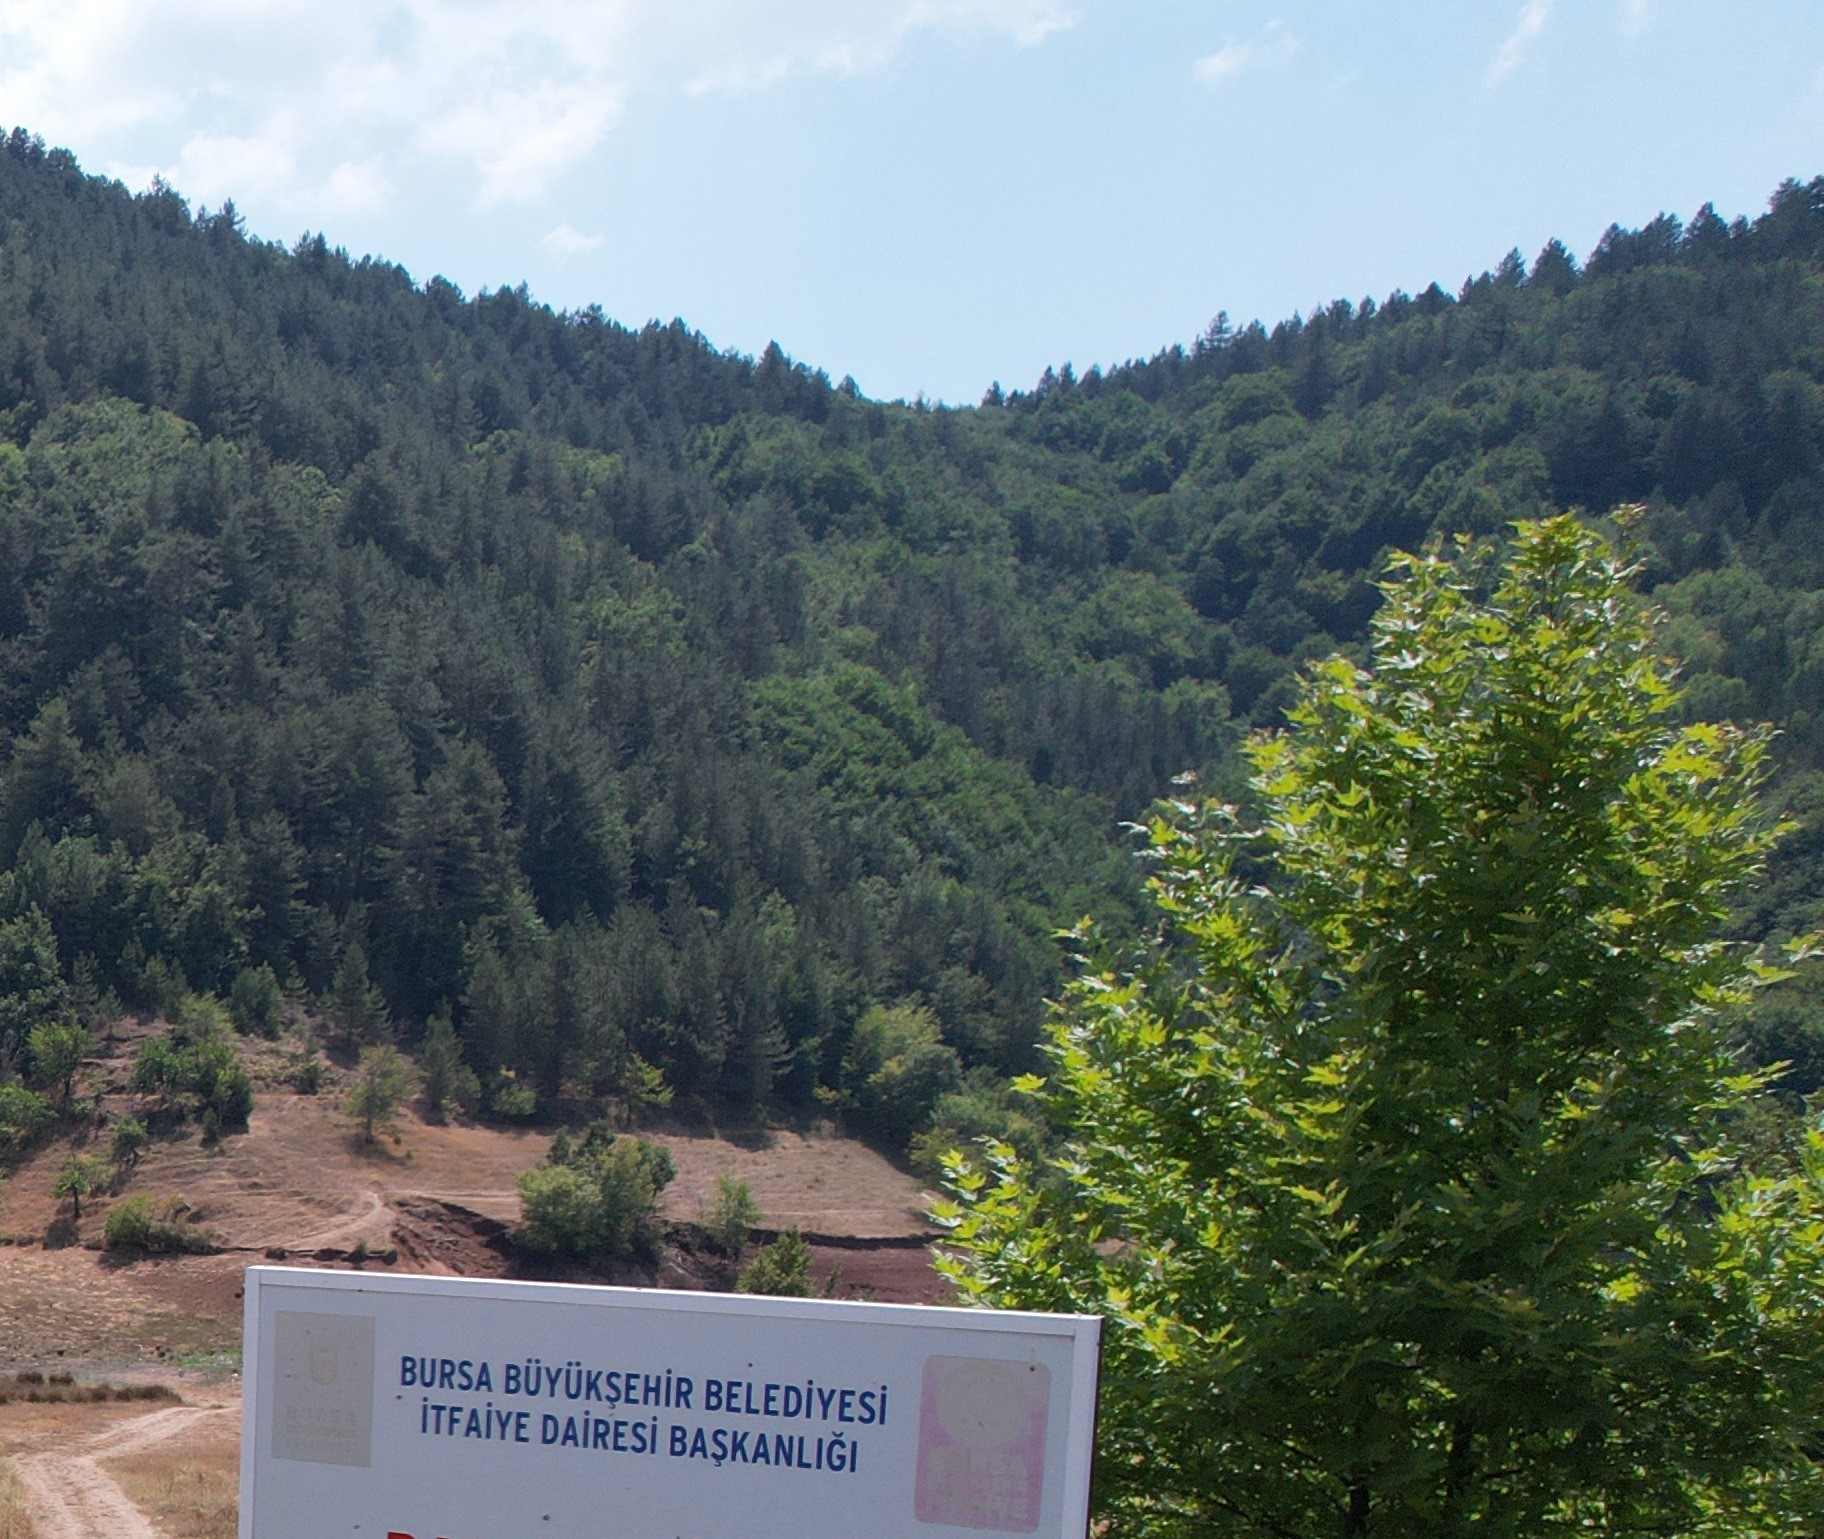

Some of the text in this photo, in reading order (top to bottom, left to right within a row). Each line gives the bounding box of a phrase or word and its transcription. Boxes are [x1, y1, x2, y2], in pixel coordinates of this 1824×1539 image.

[401, 1355, 888, 1425] BURSA BÜYÜKŞEHİR BELEDİYESİ
[420, 1397, 858, 1473] İTFAİYE DAİRESİ BAŞKANLIĞI
